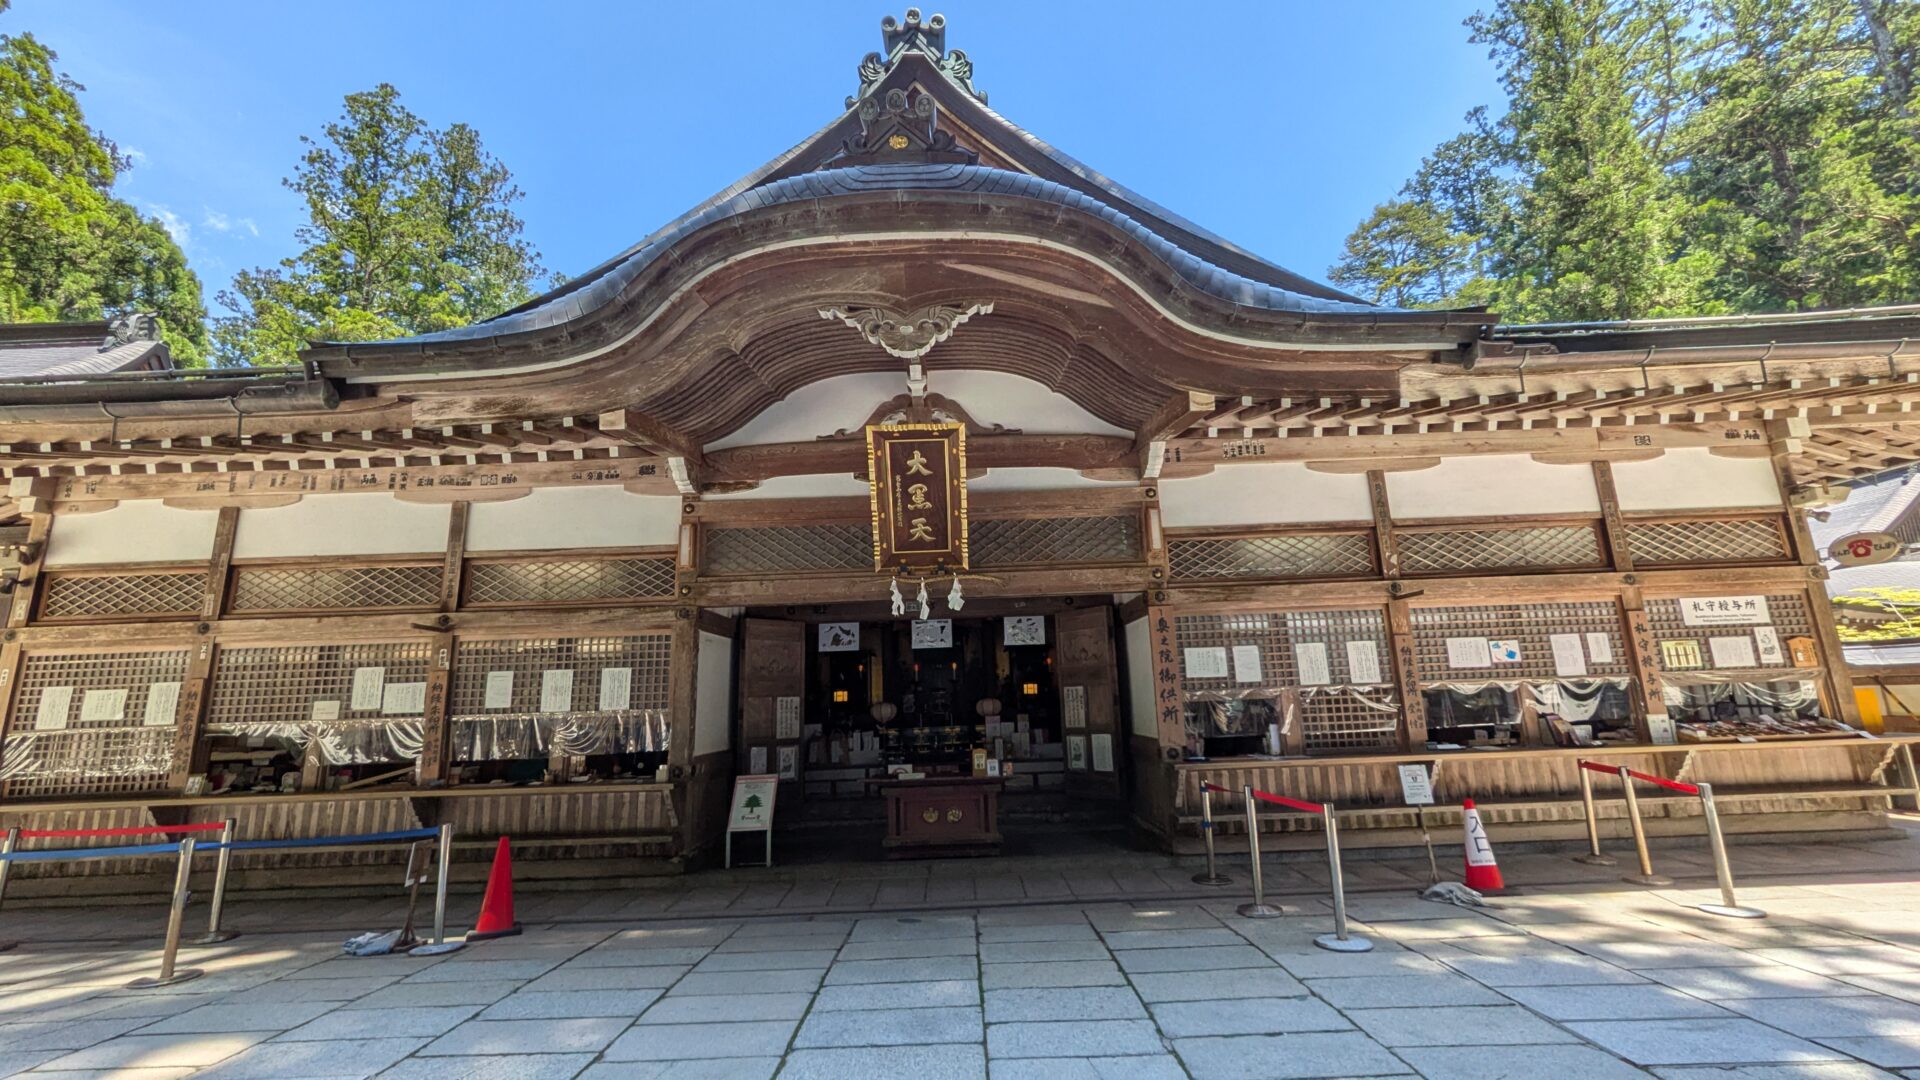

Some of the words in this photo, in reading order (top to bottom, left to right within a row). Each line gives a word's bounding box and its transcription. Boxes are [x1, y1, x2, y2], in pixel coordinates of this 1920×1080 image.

[1692, 600, 1756, 612] 札守授与所
[1157, 617, 1180, 725] 奥之院御供所
[1634, 622, 1661, 702] 札守授与所
[1469, 816, 1491, 853] 入口
